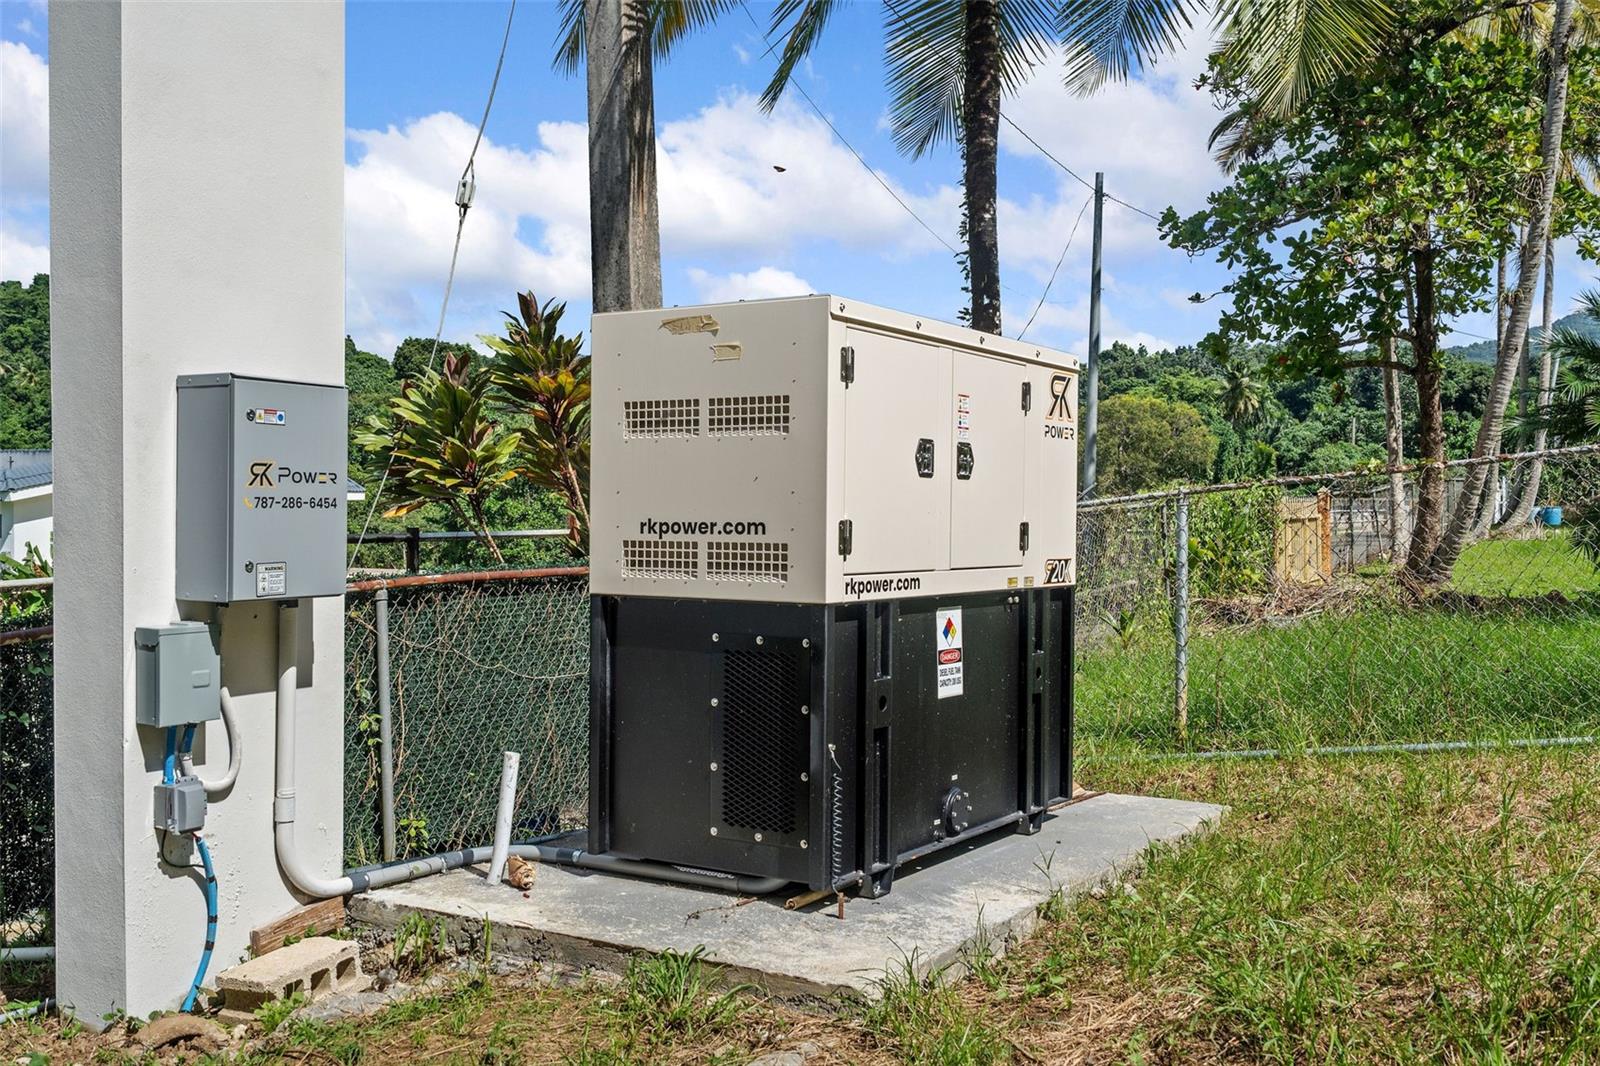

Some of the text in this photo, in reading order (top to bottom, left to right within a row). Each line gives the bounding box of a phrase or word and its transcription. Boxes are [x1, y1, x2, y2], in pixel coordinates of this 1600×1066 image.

[1044, 425, 1075, 440] POWER
[254, 496, 337, 509] 787-286-6454
[639, 518, 766, 539] rkpower.com
[845, 577, 921, 600] rkpower.com
[940, 652, 959, 661] DANGER
